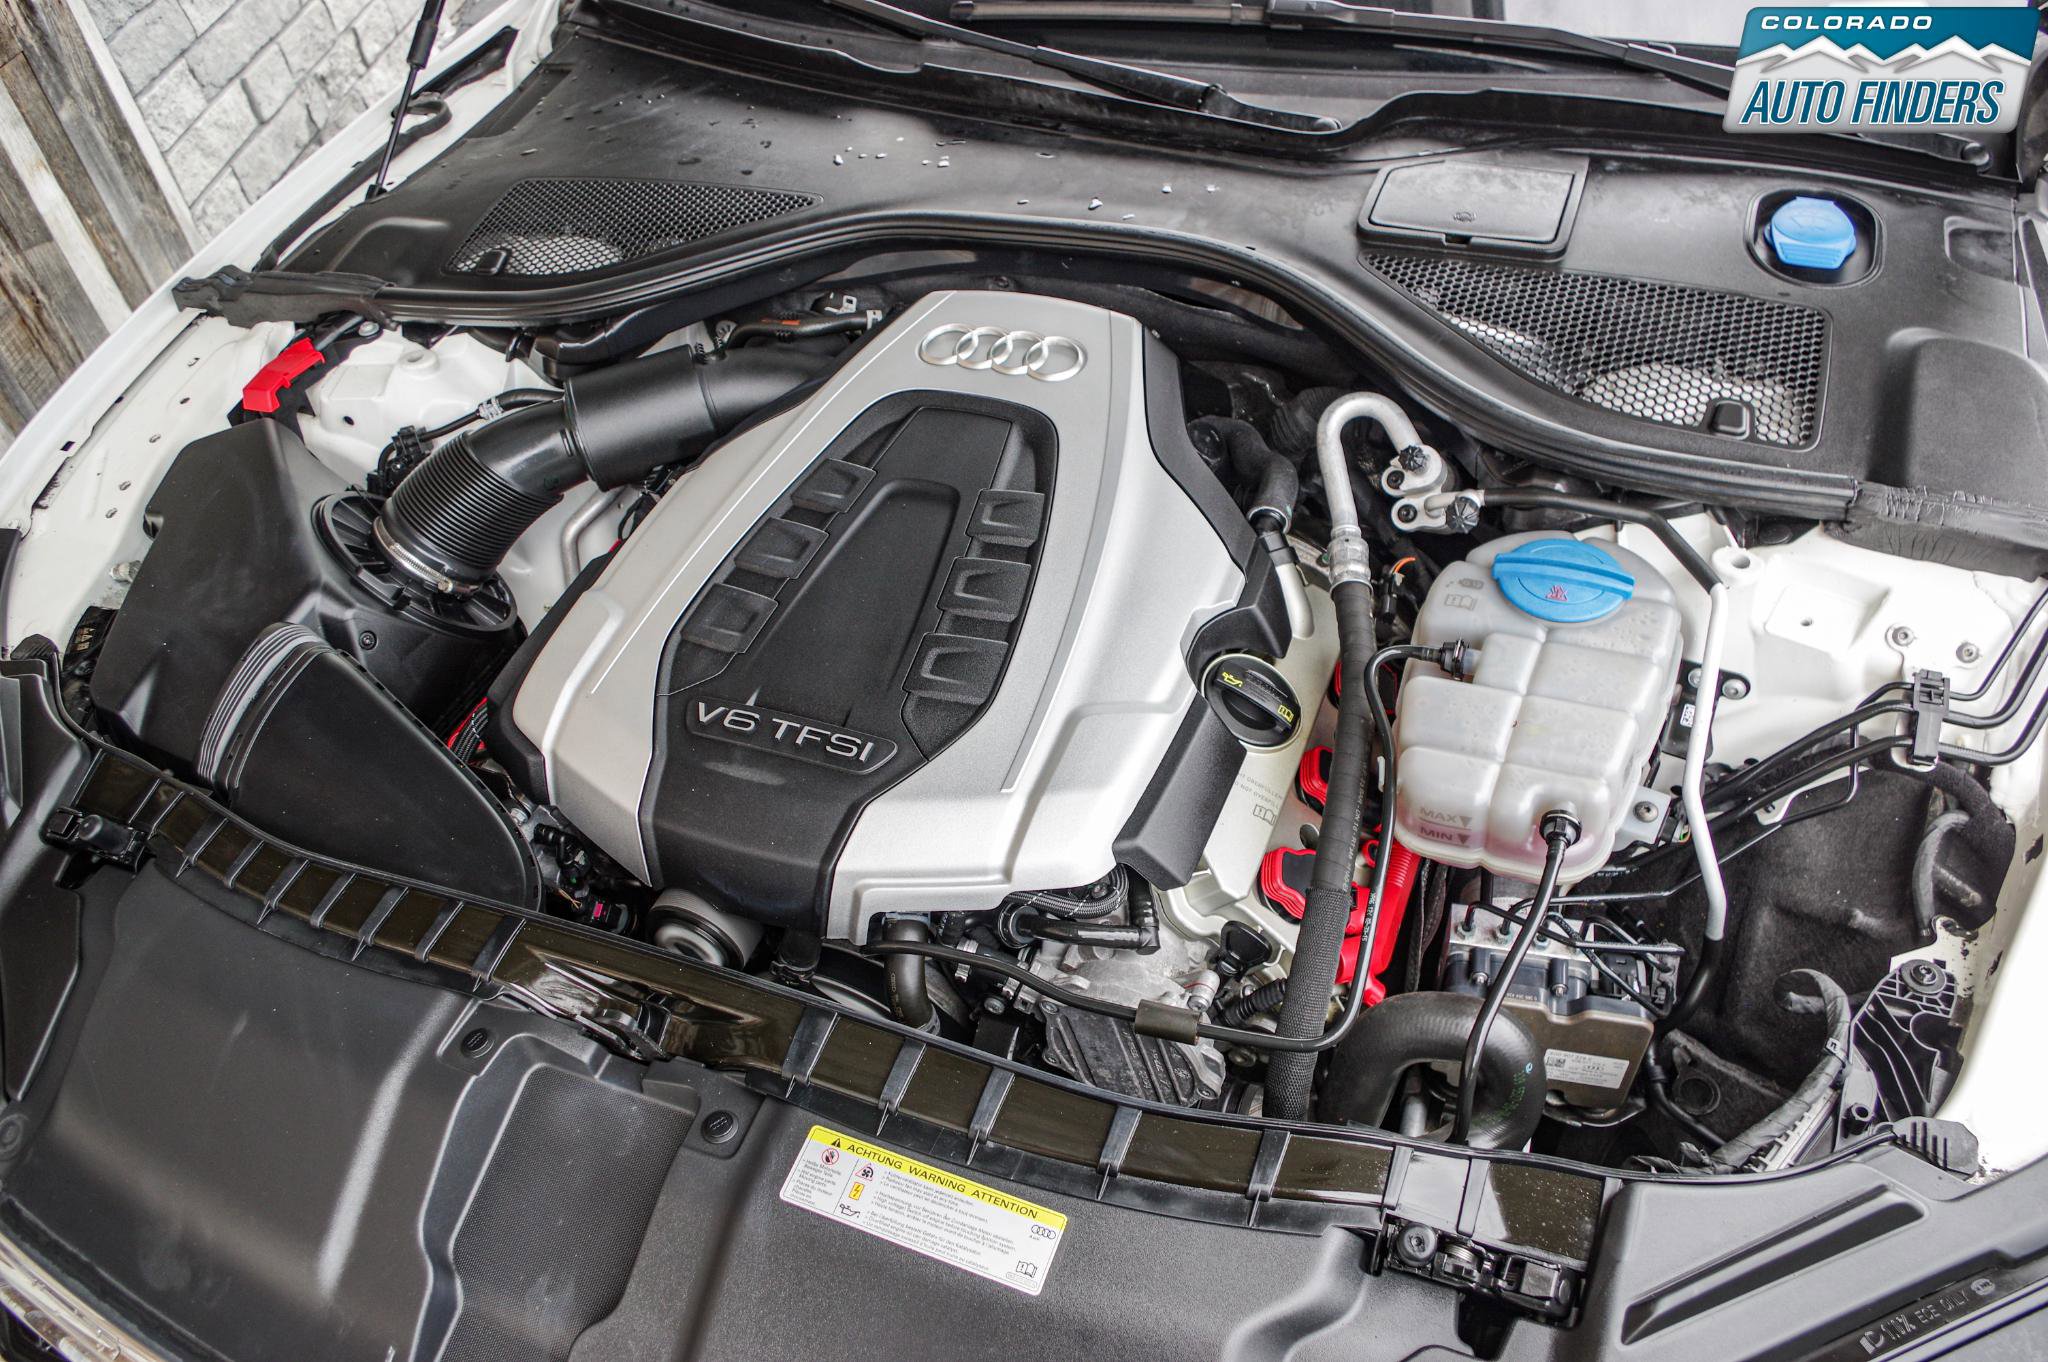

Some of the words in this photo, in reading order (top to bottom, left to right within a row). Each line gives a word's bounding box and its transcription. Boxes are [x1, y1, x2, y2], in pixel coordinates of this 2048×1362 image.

[698, 701, 761, 732] V6
[772, 717, 874, 764] TFSI
[1420, 807, 1458, 824] MAX
[1420, 827, 1453, 841] MIN
[846, 1144, 903, 1170] ACHTUNG
[909, 1164, 966, 1194] WARNING
[971, 1189, 1038, 1219] ATTENTION
